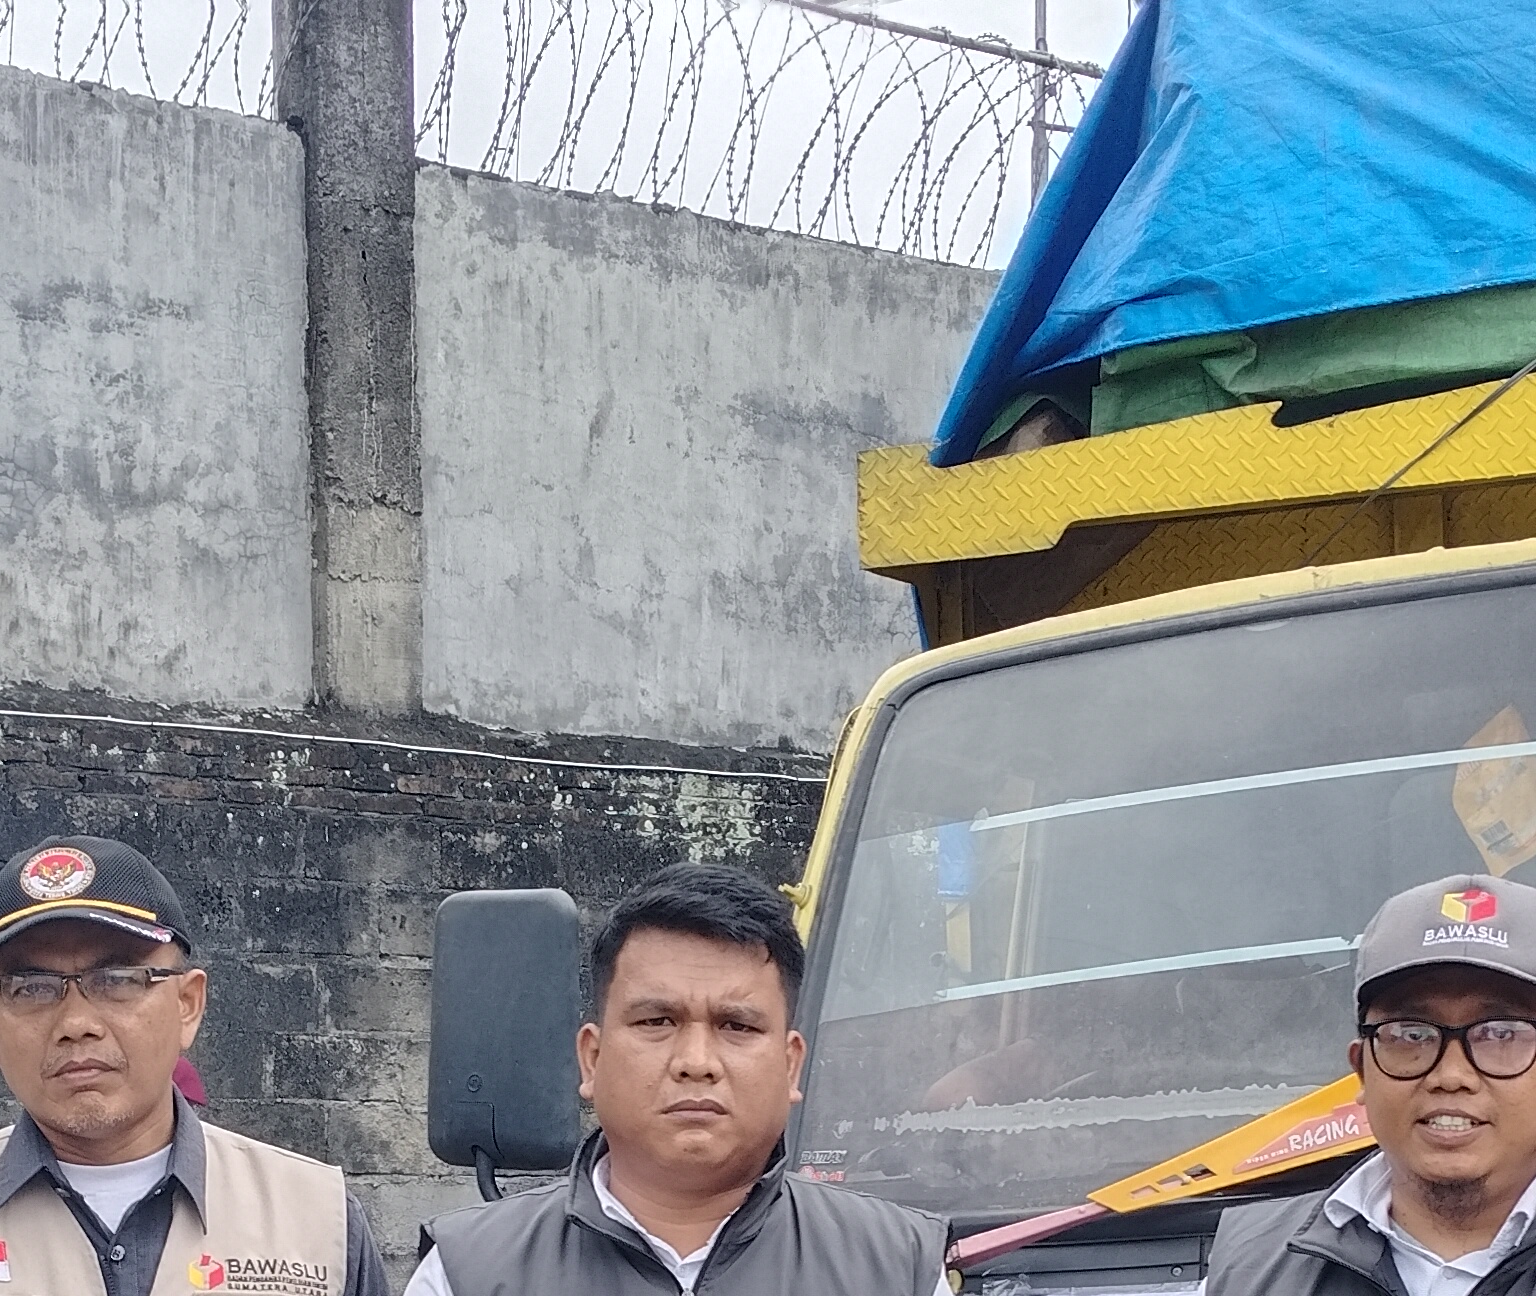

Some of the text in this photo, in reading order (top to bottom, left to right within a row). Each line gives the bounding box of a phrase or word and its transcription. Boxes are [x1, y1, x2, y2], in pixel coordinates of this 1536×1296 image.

[1424, 923, 1508, 944] BAWASLU
[1288, 1114, 1360, 1151] RACING
[225, 1259, 327, 1281] BAWASLU
[227, 1283, 288, 1292] SUMATERA
